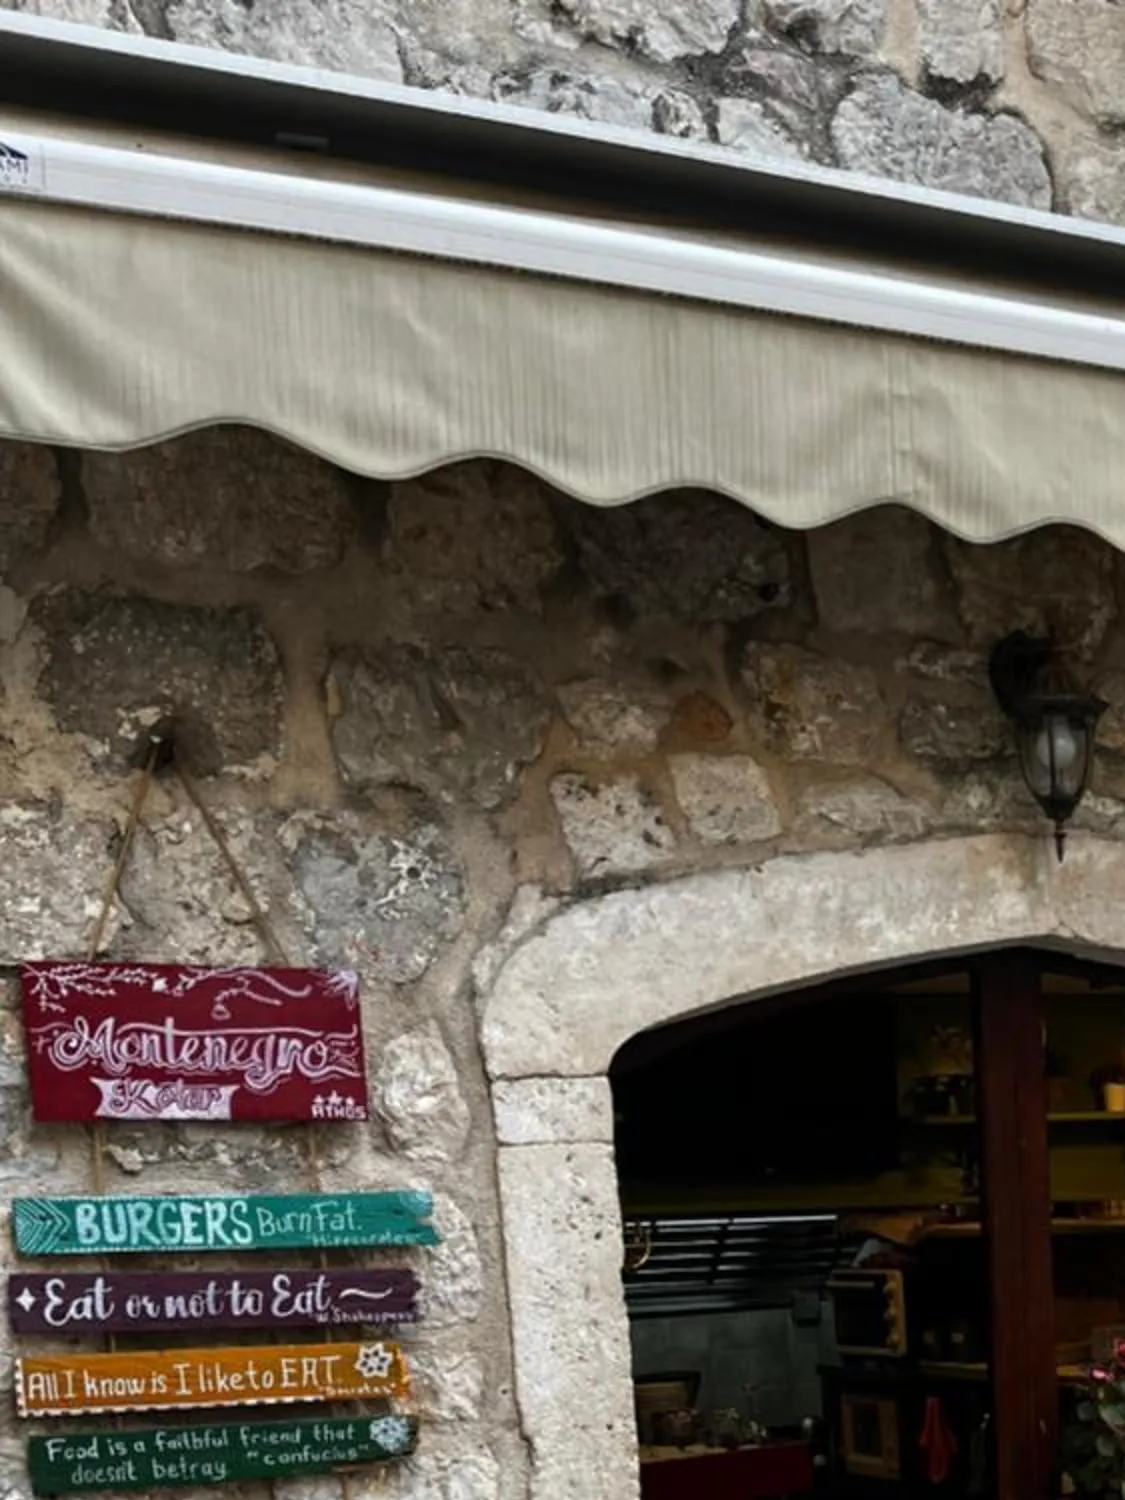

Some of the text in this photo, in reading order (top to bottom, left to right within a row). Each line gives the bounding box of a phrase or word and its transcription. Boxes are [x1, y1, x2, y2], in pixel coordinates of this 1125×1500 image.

[48, 1016, 332, 1092] Montenegro
[109, 1076, 223, 1115] Kotor
[311, 1103, 367, 1120] ATHOS
[75, 1195, 254, 1247] BURGERS
[44, 1273, 332, 1326] Eat or not to Eat
[28, 1355, 342, 1401] All I know is I like to EAT
[45, 1423, 356, 1463] Food is a faithful friend that
[152, 1456, 227, 1481] betray
